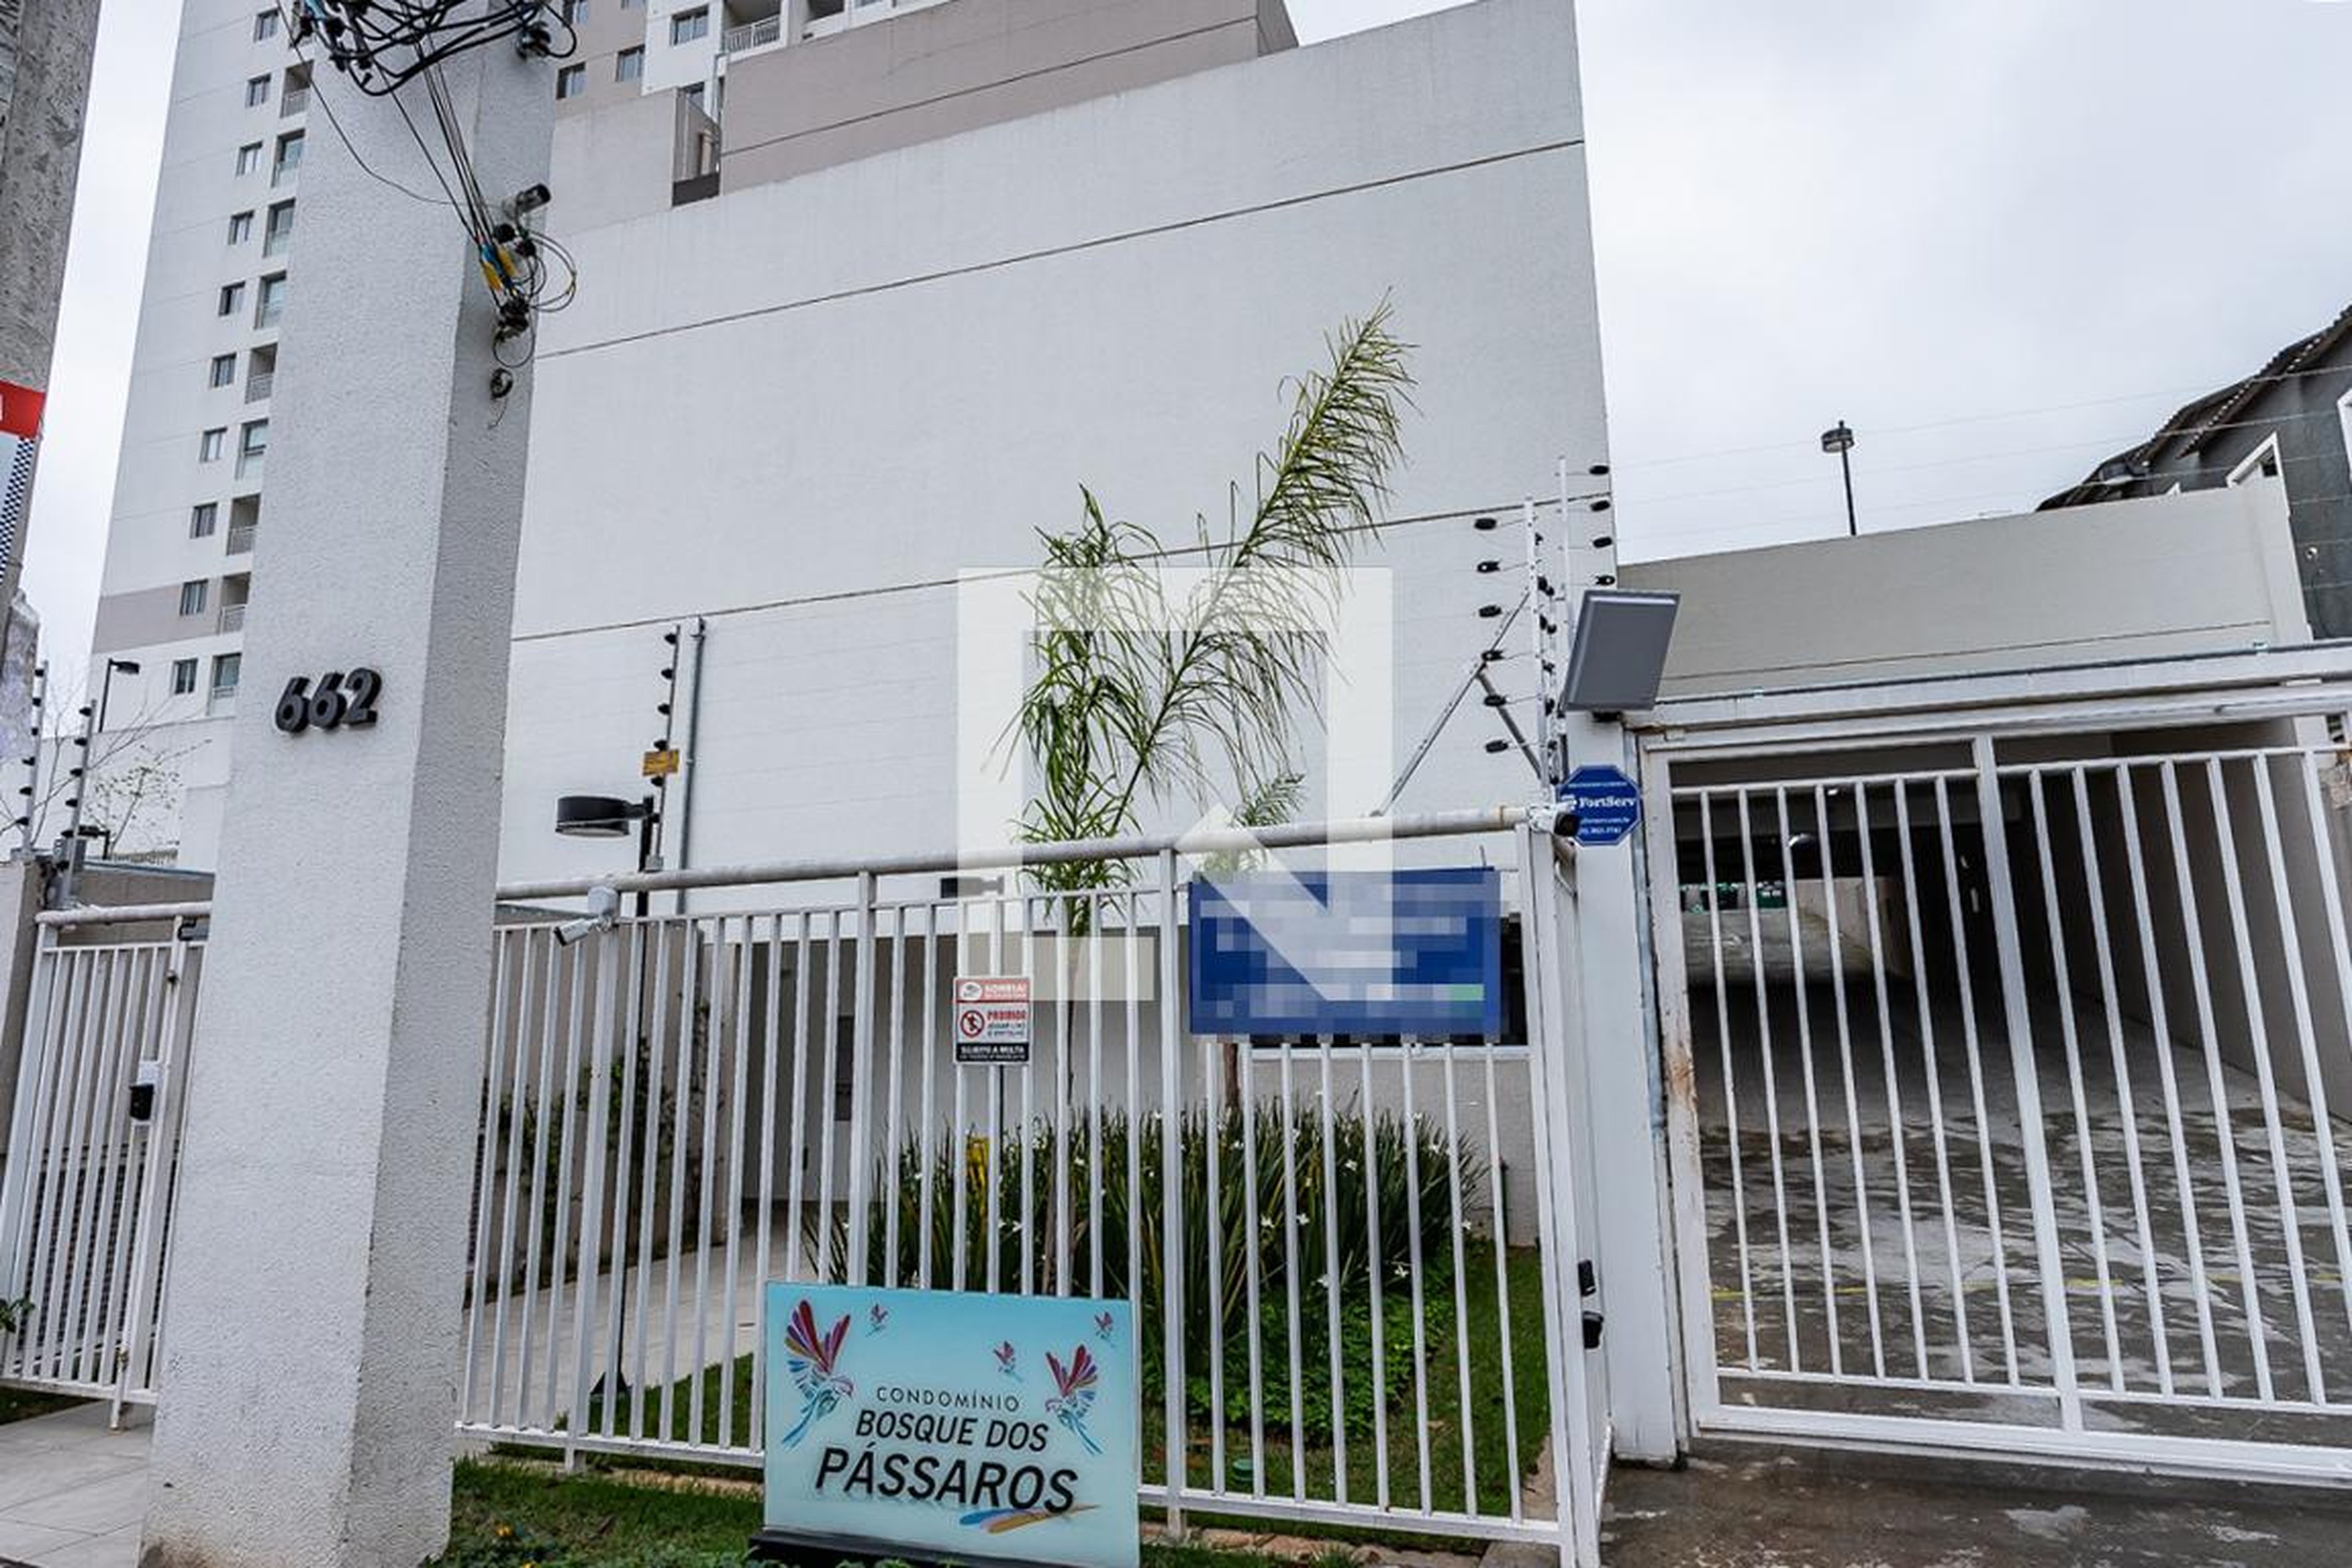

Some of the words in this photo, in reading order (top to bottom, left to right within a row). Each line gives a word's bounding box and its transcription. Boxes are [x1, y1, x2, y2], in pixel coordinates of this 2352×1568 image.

[276, 667, 382, 733] 662
[1578, 796, 1637, 810] FortServ
[876, 1385, 1019, 1412] CONDOMÍNIO
[856, 1410, 978, 1446] BOSQUE
[986, 1419, 1049, 1452] DOS
[815, 1441, 1079, 1513] PÁSSAROS
